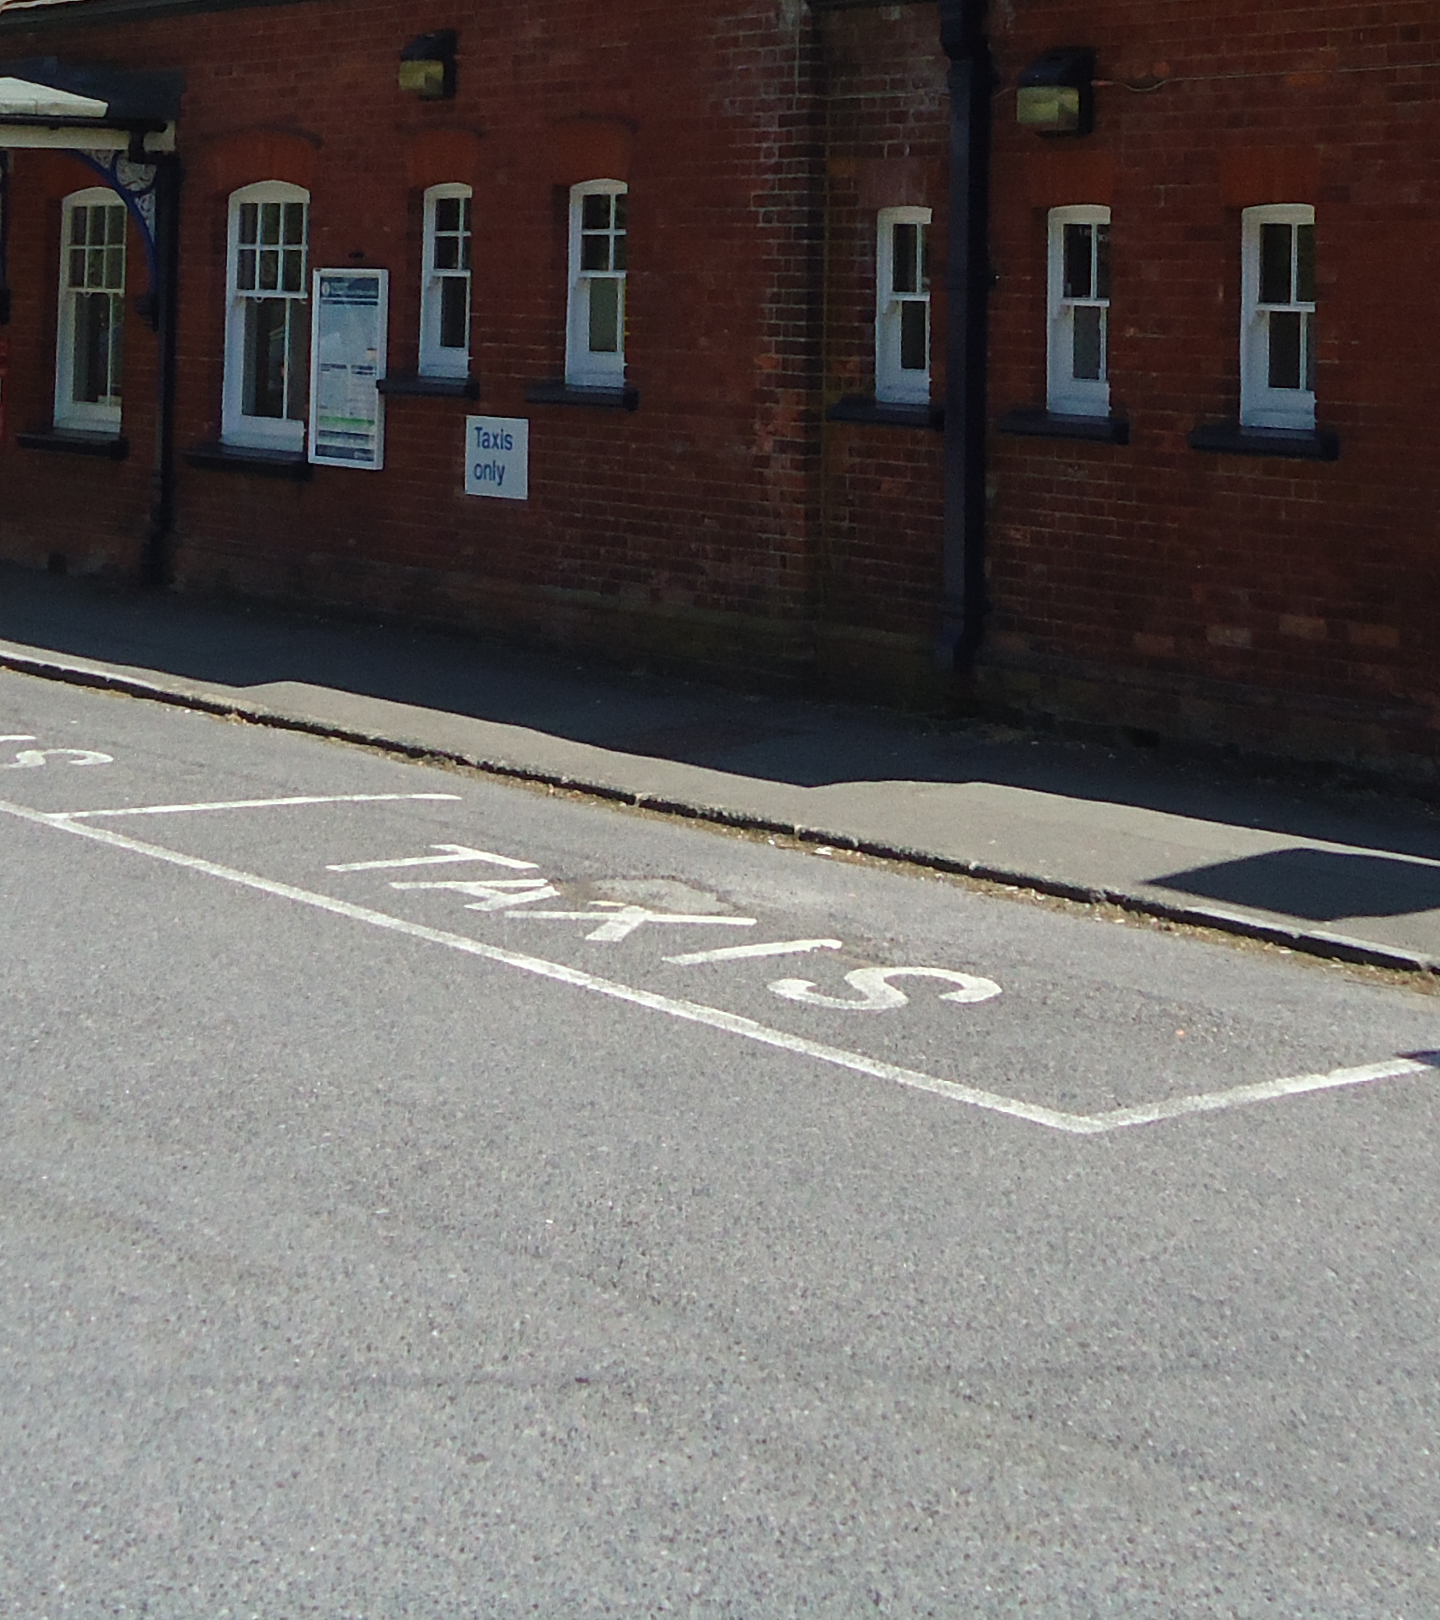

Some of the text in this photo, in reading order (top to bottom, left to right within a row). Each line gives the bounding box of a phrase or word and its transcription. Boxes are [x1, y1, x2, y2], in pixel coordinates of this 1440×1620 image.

[474, 426, 513, 451] Taxis
[474, 460, 506, 486] only
[325, 843, 1003, 1011] TAXIS
